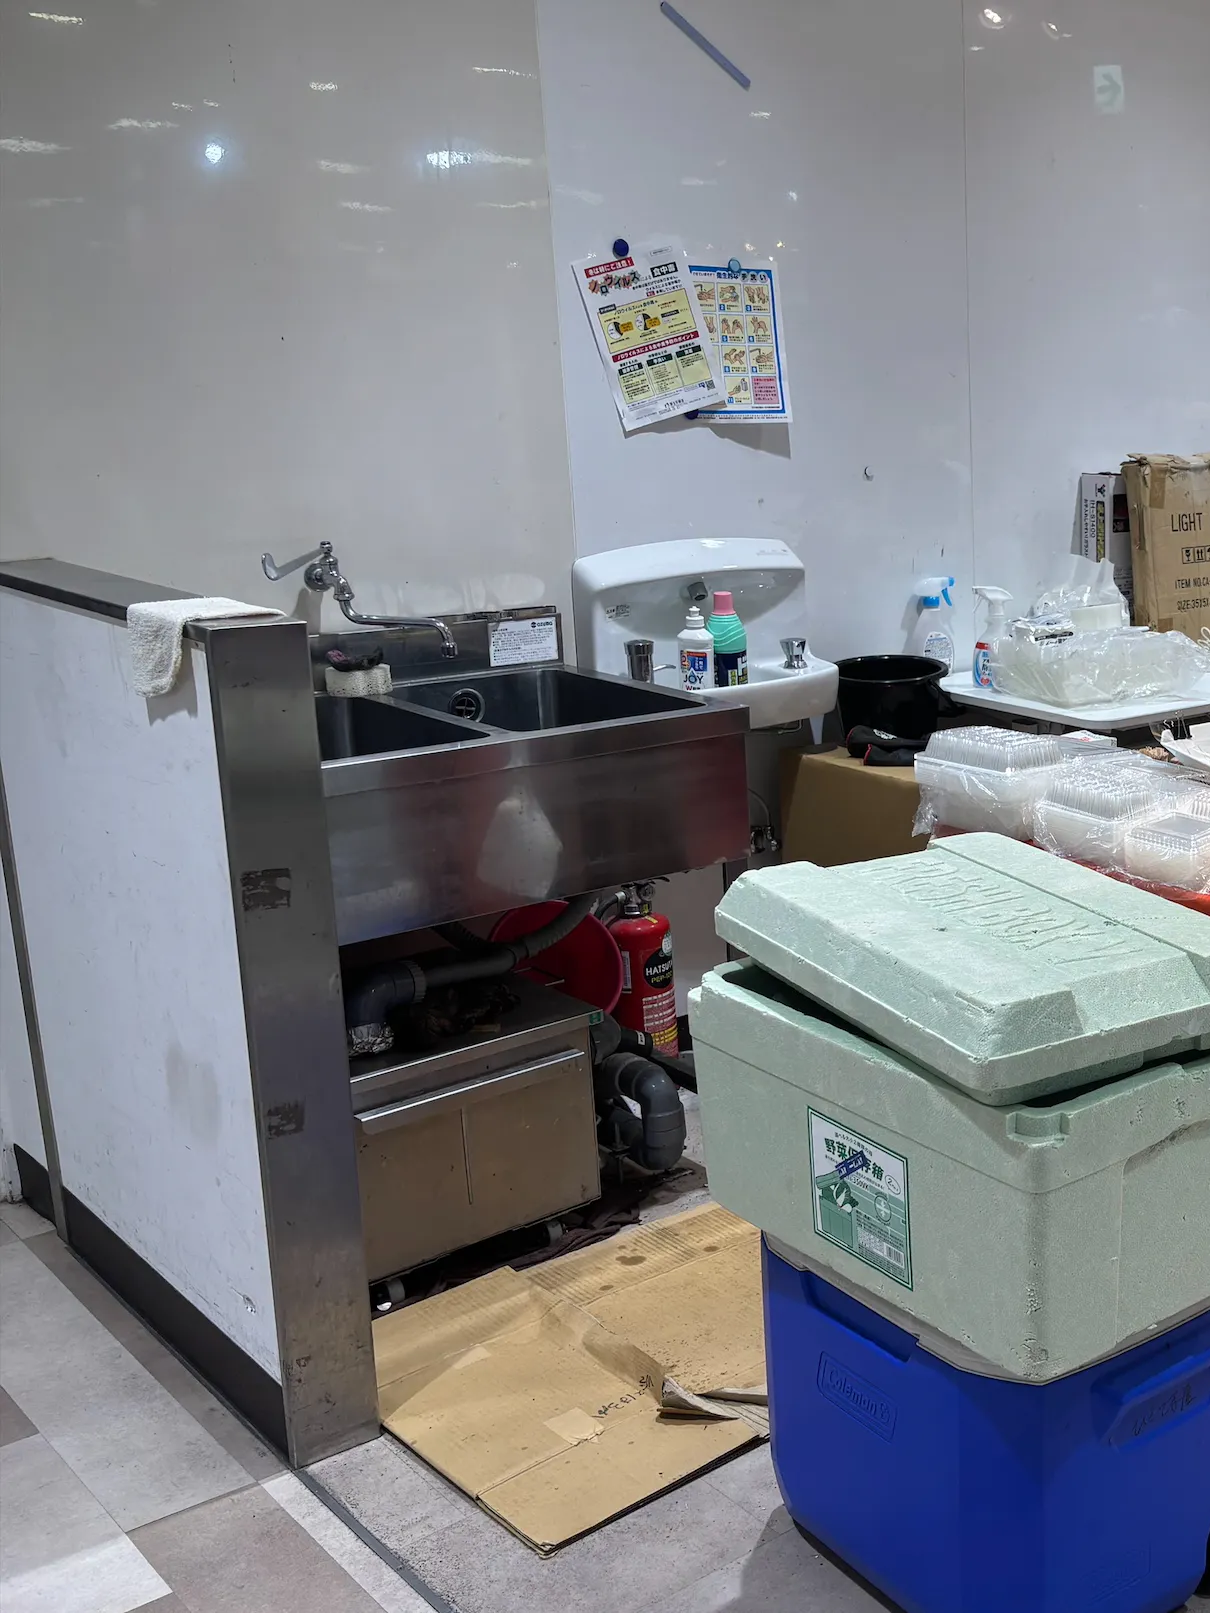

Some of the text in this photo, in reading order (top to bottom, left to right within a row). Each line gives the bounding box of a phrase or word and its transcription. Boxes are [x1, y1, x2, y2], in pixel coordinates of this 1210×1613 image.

[1171, 512, 1203, 532] LIGHT
[1175, 578, 1191, 590] ITEM
[684, 670, 704, 685] JOY
[827, 1366, 879, 1417] Coleman
